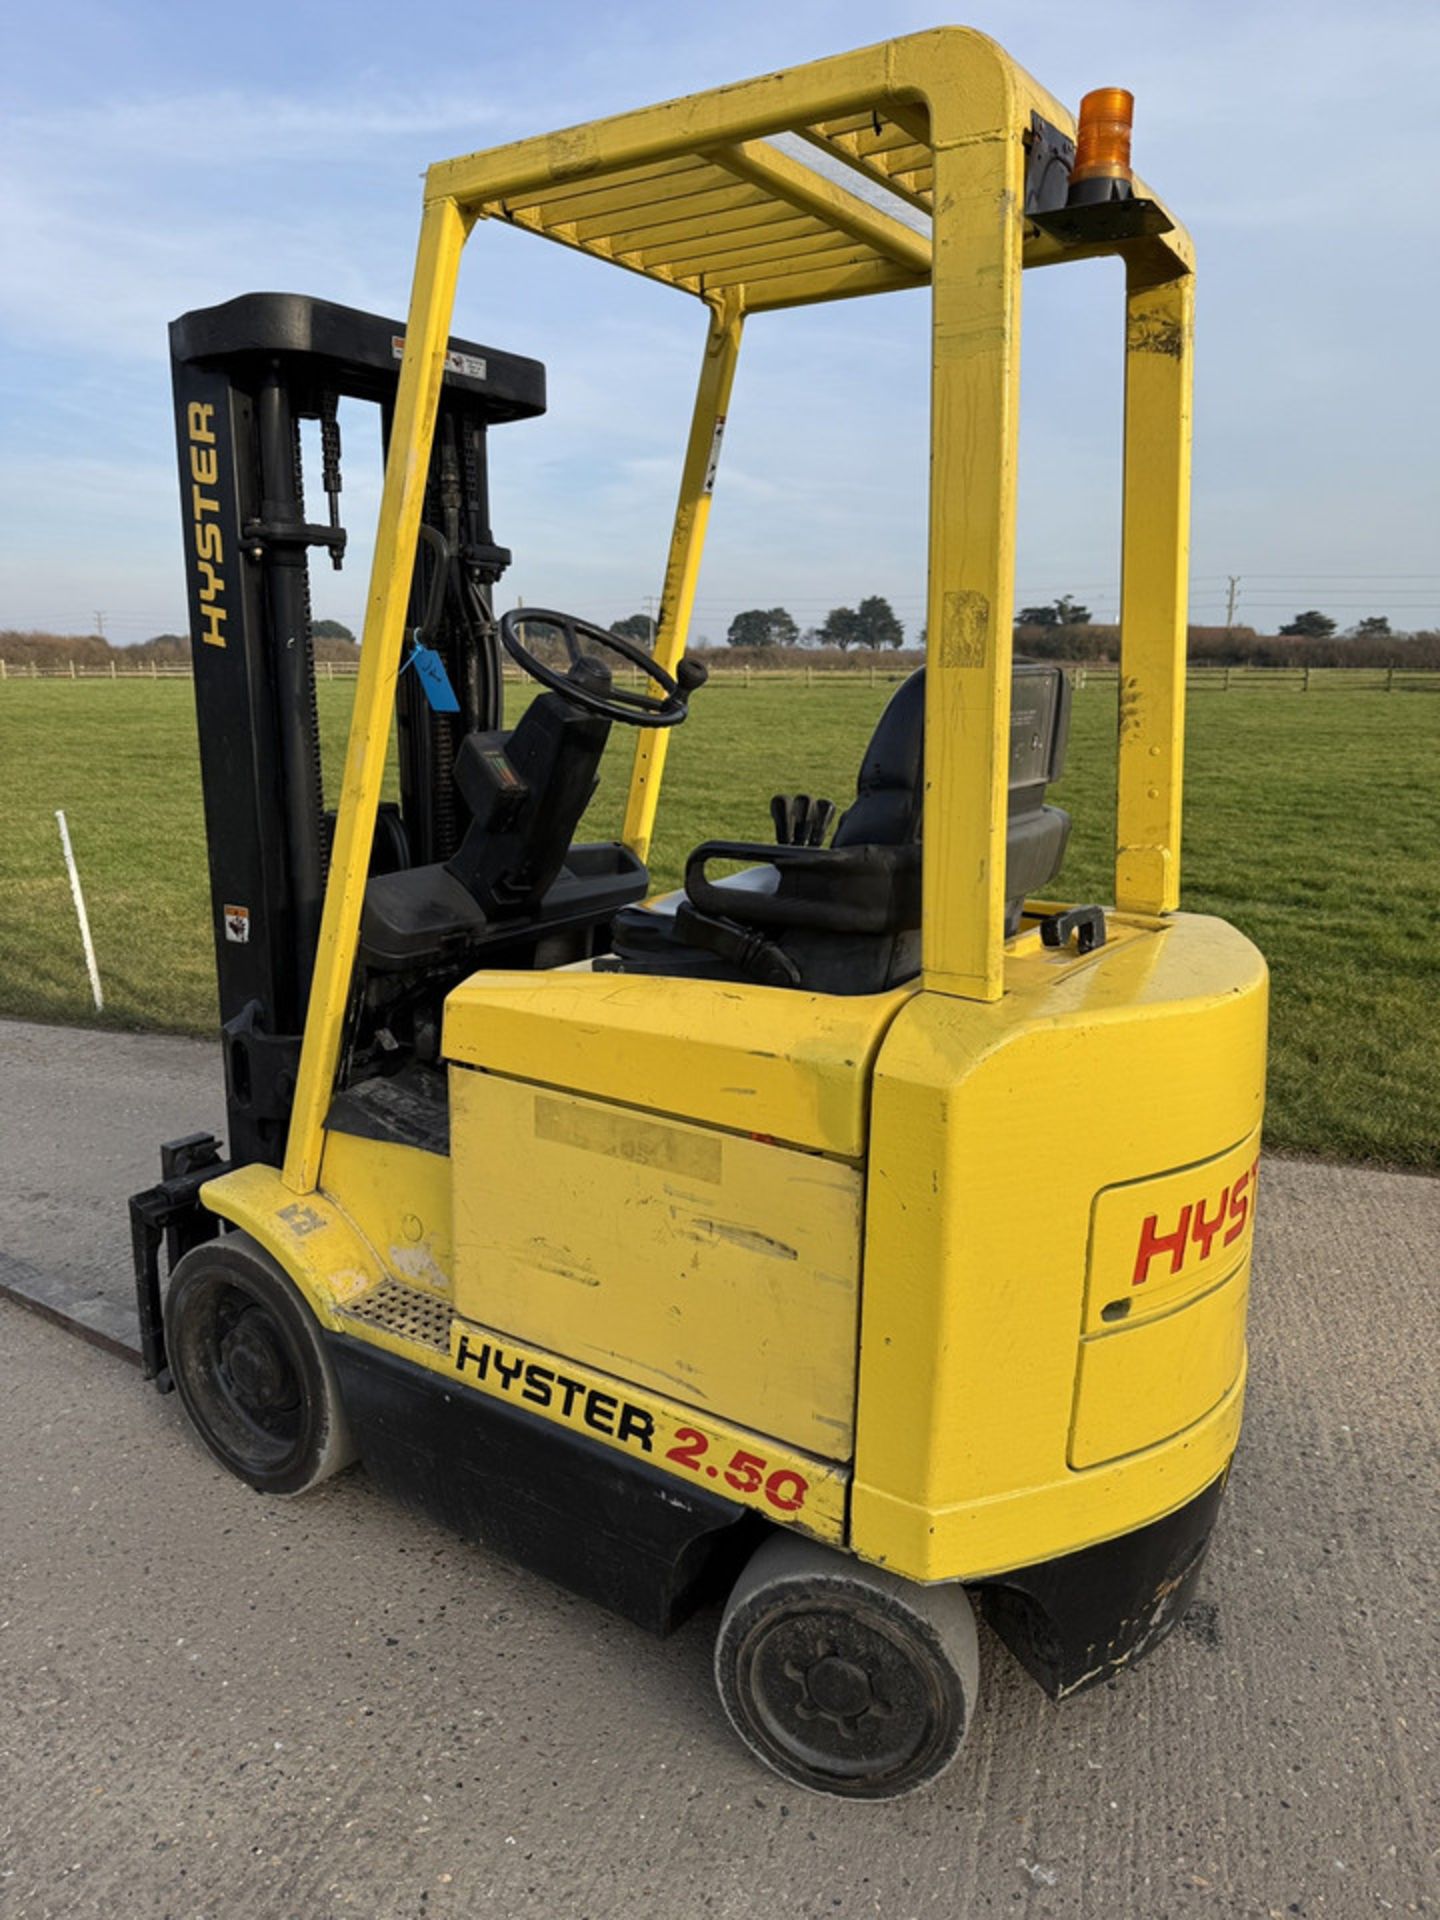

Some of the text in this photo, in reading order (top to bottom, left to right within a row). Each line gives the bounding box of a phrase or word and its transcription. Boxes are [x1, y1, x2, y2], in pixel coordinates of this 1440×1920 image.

[188, 402, 228, 647] HYSTER
[456, 1337, 809, 1511] HYSTER 2.50
